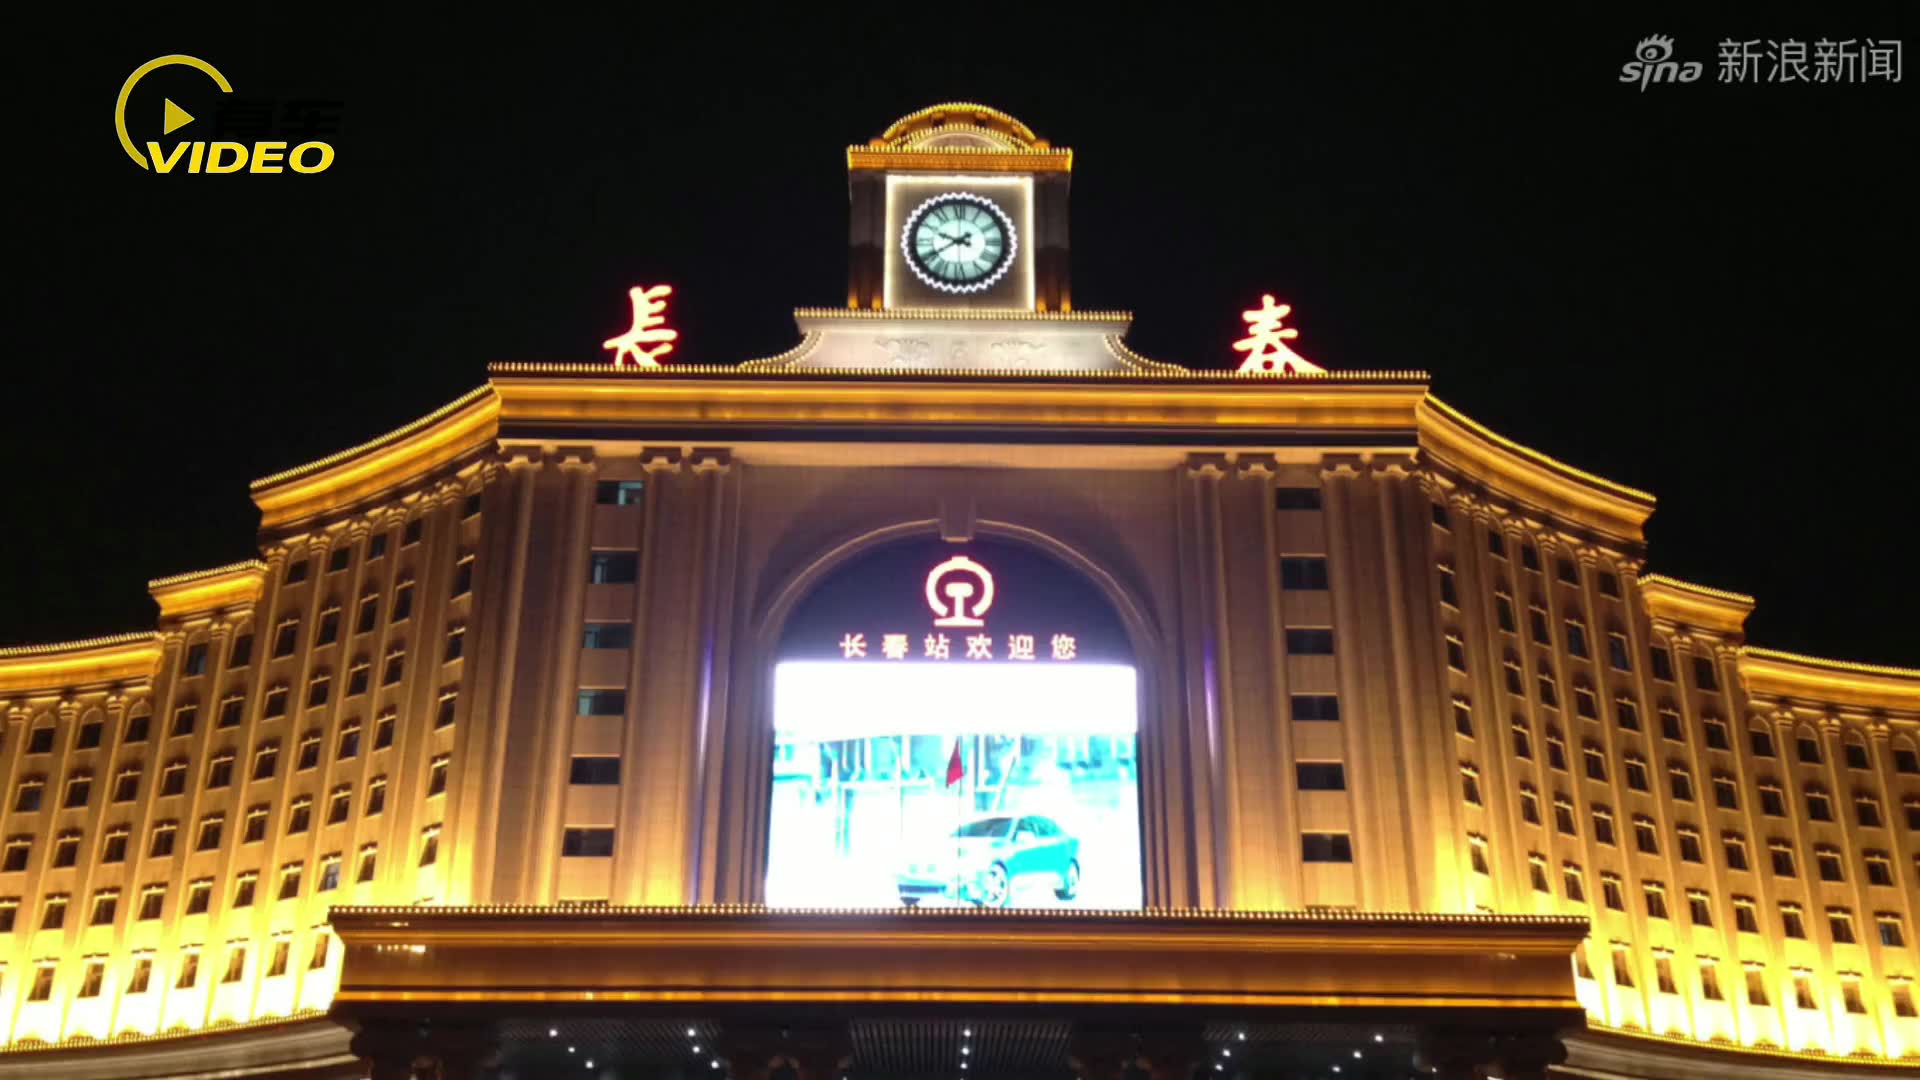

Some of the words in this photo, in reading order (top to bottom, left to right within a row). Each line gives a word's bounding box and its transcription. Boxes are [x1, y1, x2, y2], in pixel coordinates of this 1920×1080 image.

[839, 633, 1077, 660] 长春站欢迎您
